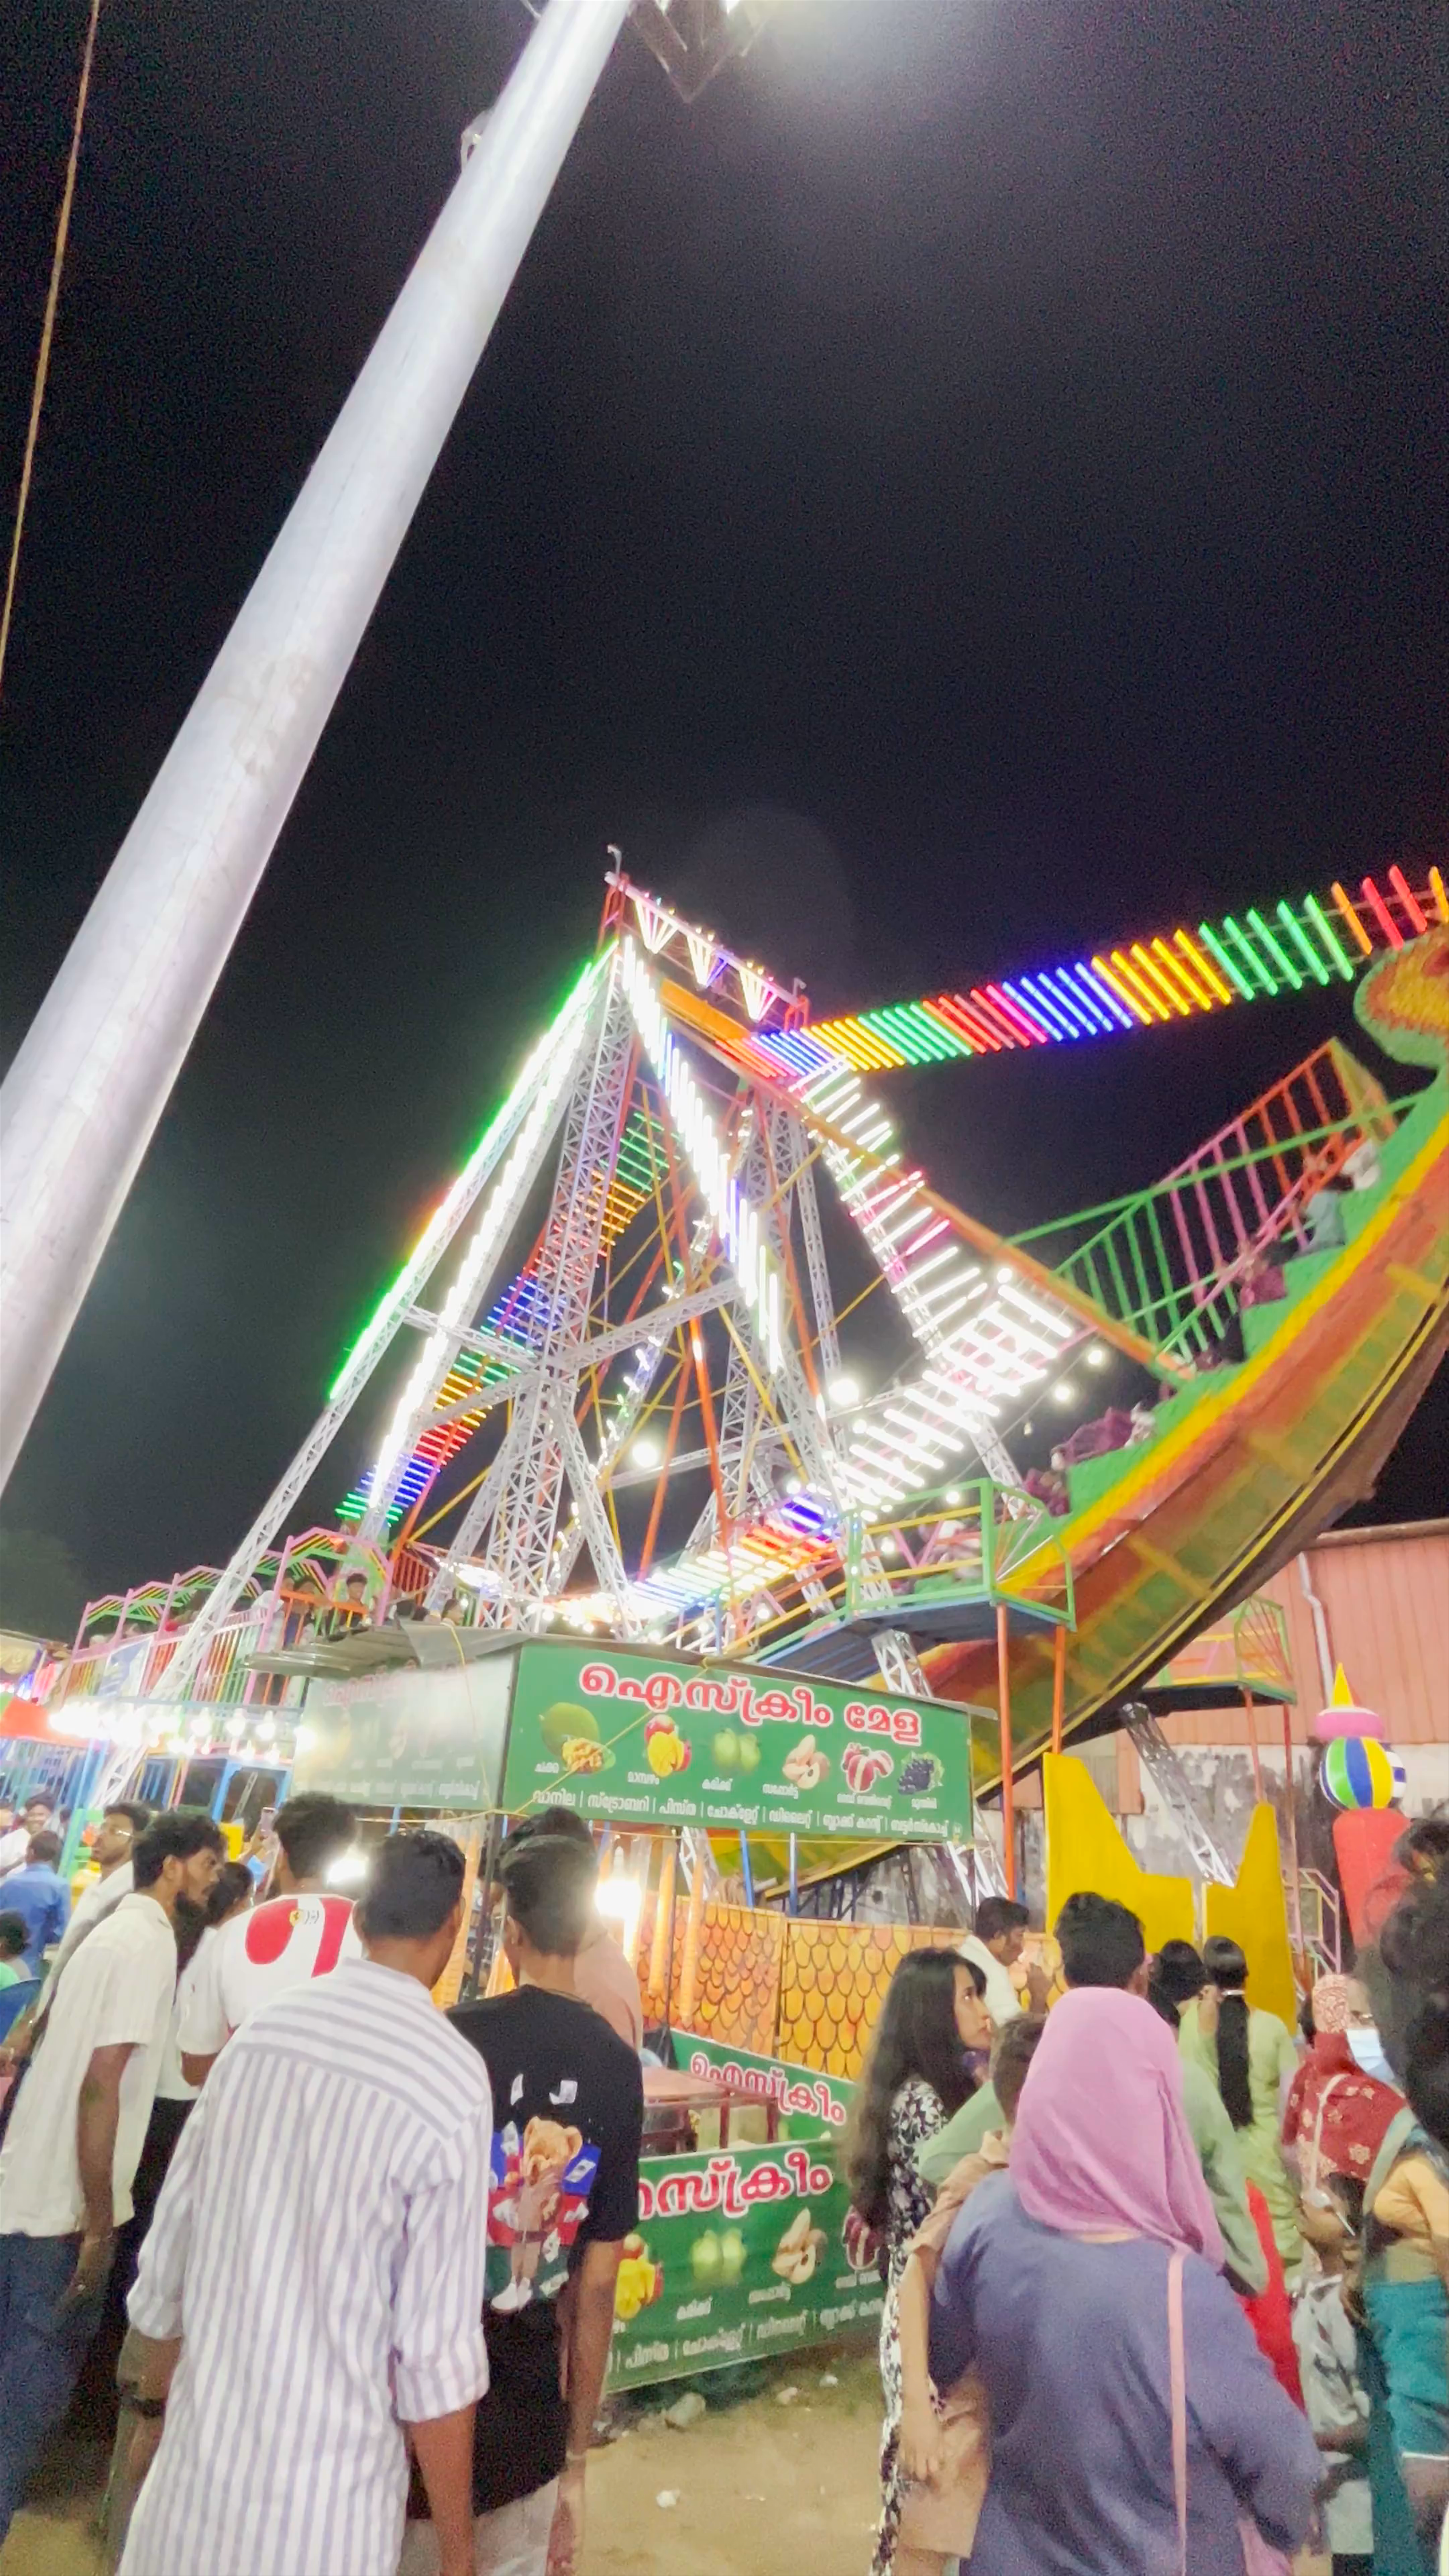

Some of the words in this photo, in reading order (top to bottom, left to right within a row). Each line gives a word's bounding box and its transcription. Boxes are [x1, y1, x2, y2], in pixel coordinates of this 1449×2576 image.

[580, 1663, 833, 1726] ഐസ്ക്രീം
[845, 1702, 921, 1745] മേള
[658, 1798, 697, 1816] പിസ്ത
[638, 2147, 833, 2220] സ്ക്രീം
